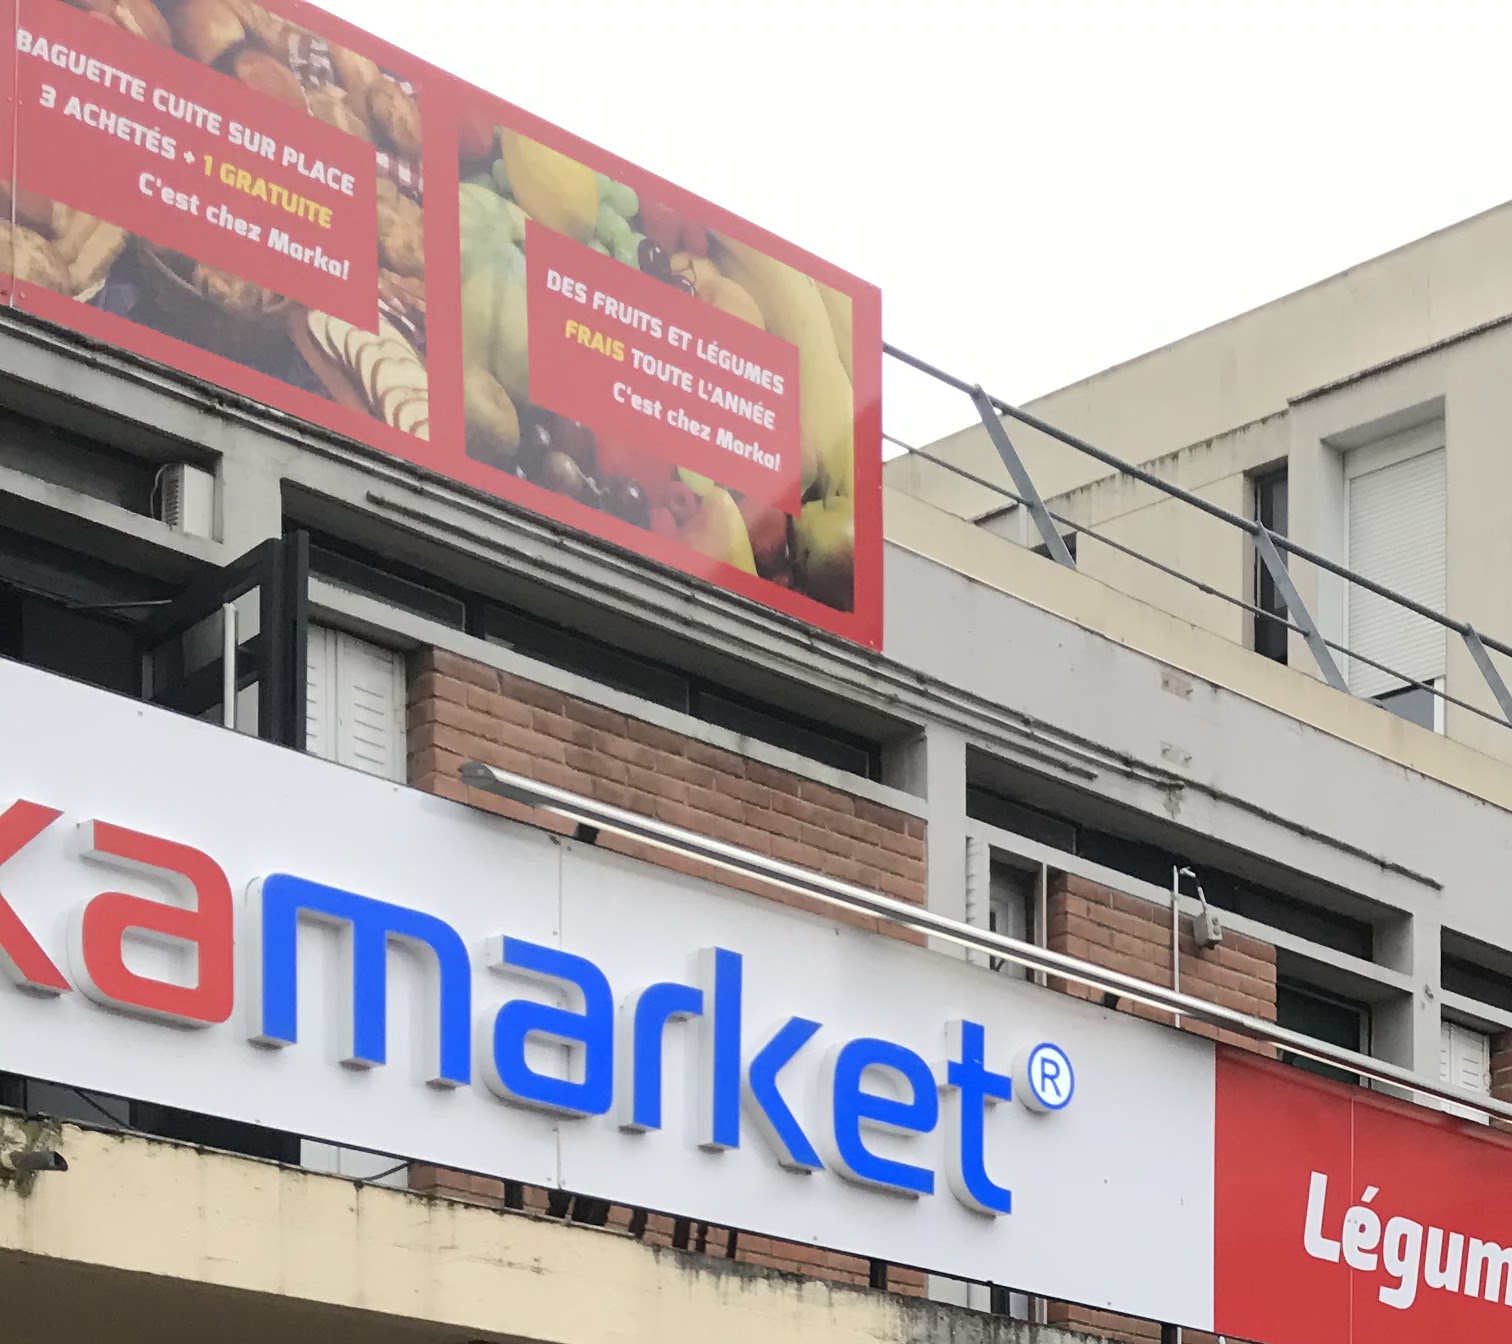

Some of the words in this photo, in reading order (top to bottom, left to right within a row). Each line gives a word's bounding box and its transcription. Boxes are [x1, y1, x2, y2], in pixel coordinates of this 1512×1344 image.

[16, 28, 147, 102] BAGUETTE
[152, 88, 222, 136] CUITE
[228, 121, 276, 160] SUR
[282, 145, 356, 197] PLACE
[39, 84, 57, 108] 3
[63, 96, 177, 160] ACHETÉS
[203, 155, 214, 176] 1
[219, 163, 333, 229] GRATUITE
[139, 172, 200, 216] C'est
[206, 204, 261, 242] chez
[546, 268, 588, 304] DES
[592, 290, 663, 339] FRUITS
[667, 325, 693, 352] ET
[697, 338, 785, 396] LÉGUMES
[565, 319, 625, 362] FRAIS
[631, 347, 694, 393] TOUTE
[698, 378, 776, 431] L'ANNÉE
[613, 381, 663, 420] C'est
[667, 408, 711, 442] chez
